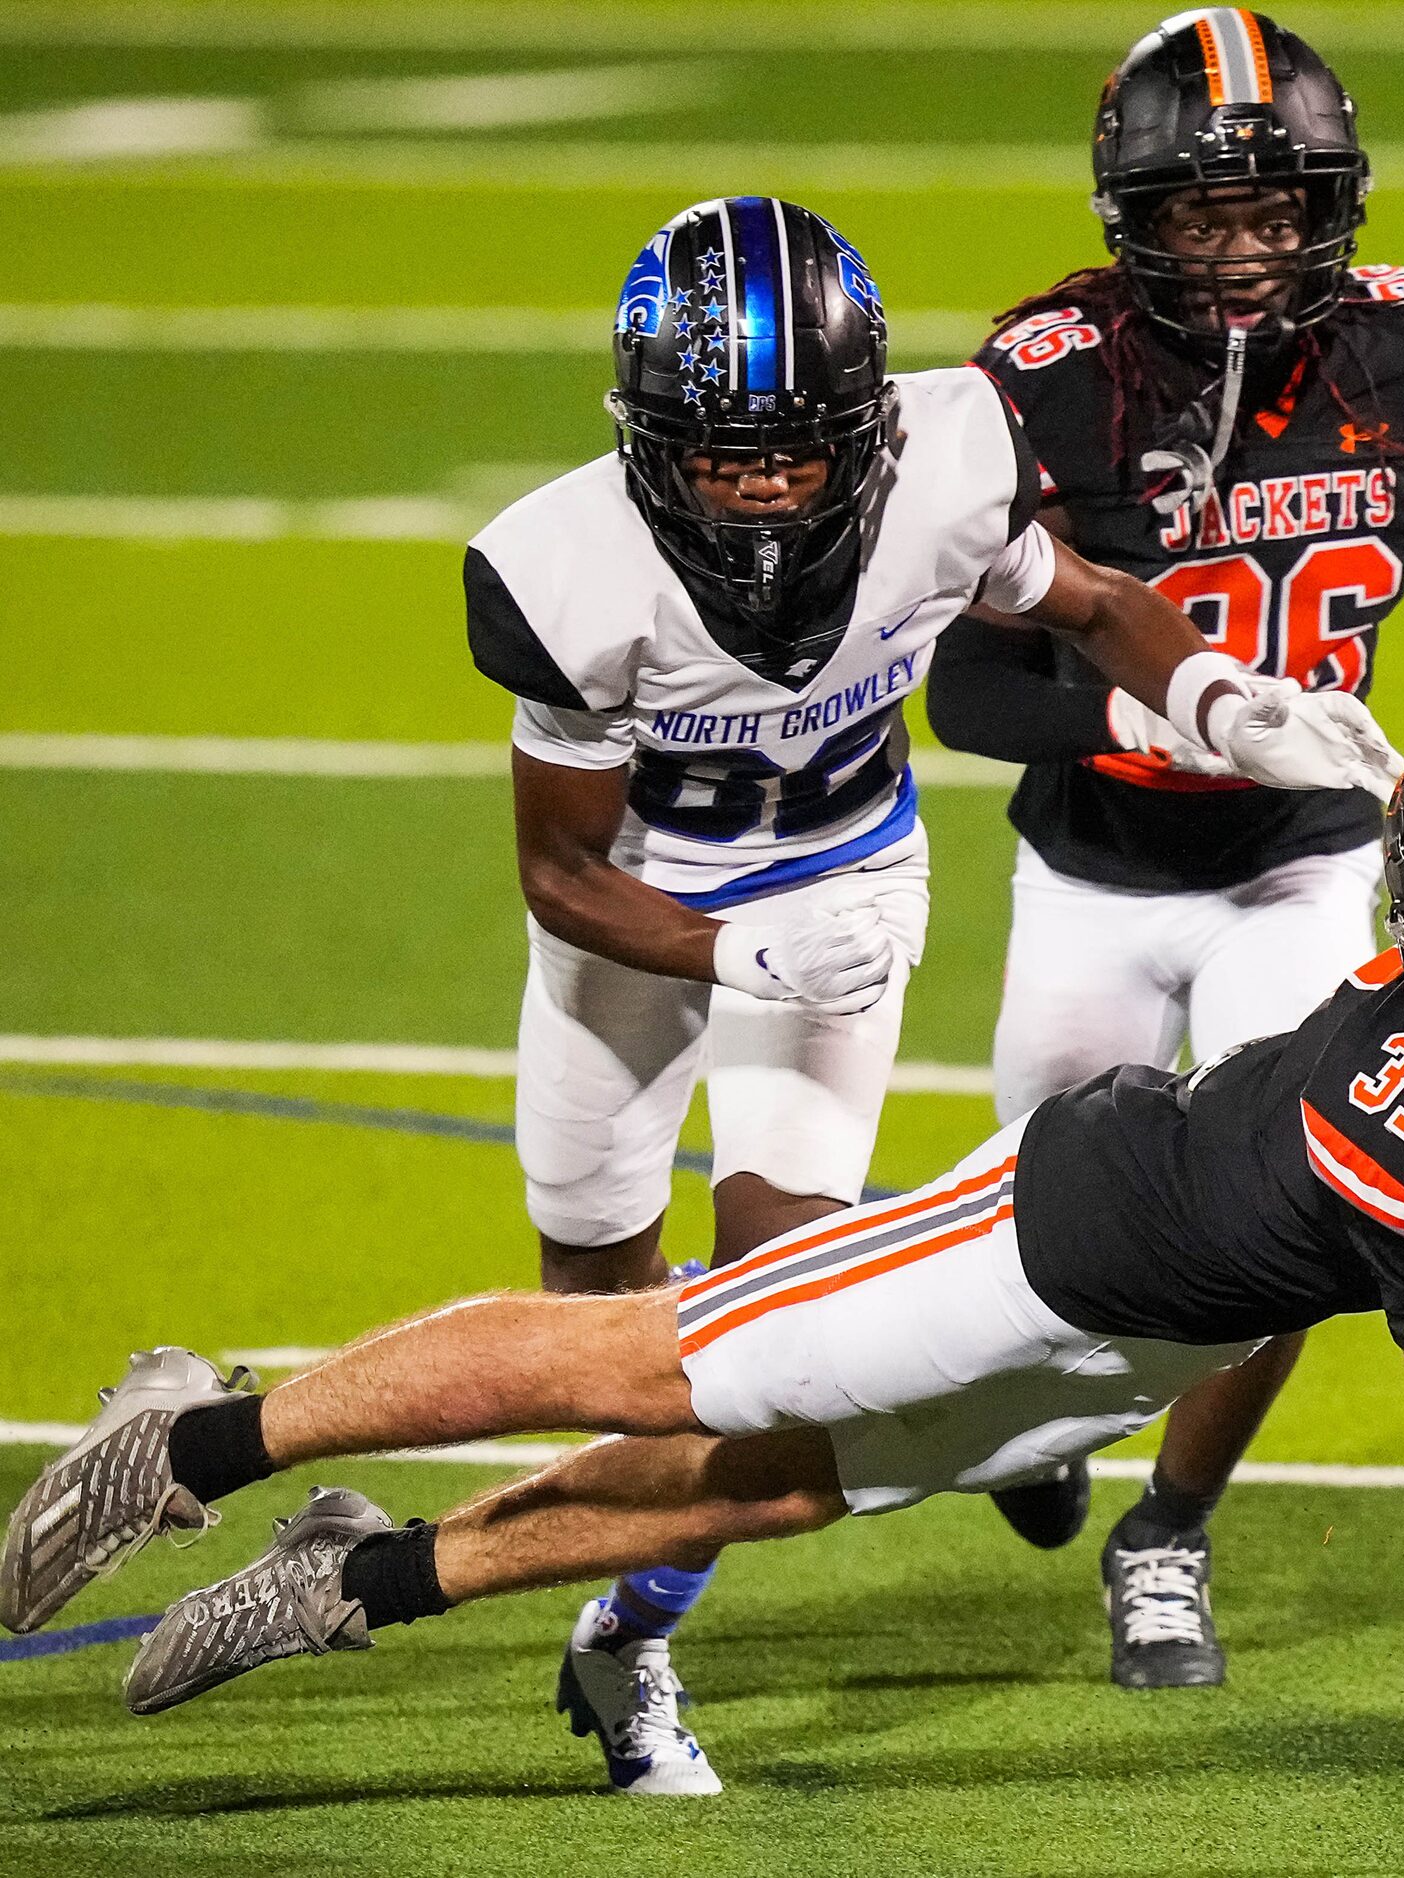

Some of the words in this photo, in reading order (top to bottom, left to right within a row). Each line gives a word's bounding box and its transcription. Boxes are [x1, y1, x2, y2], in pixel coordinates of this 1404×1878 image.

[992, 306, 1102, 371] 26
[748, 394, 776, 412] DPS
[652, 709, 762, 744] NORTH
[779, 650, 917, 741] CROWLEY
